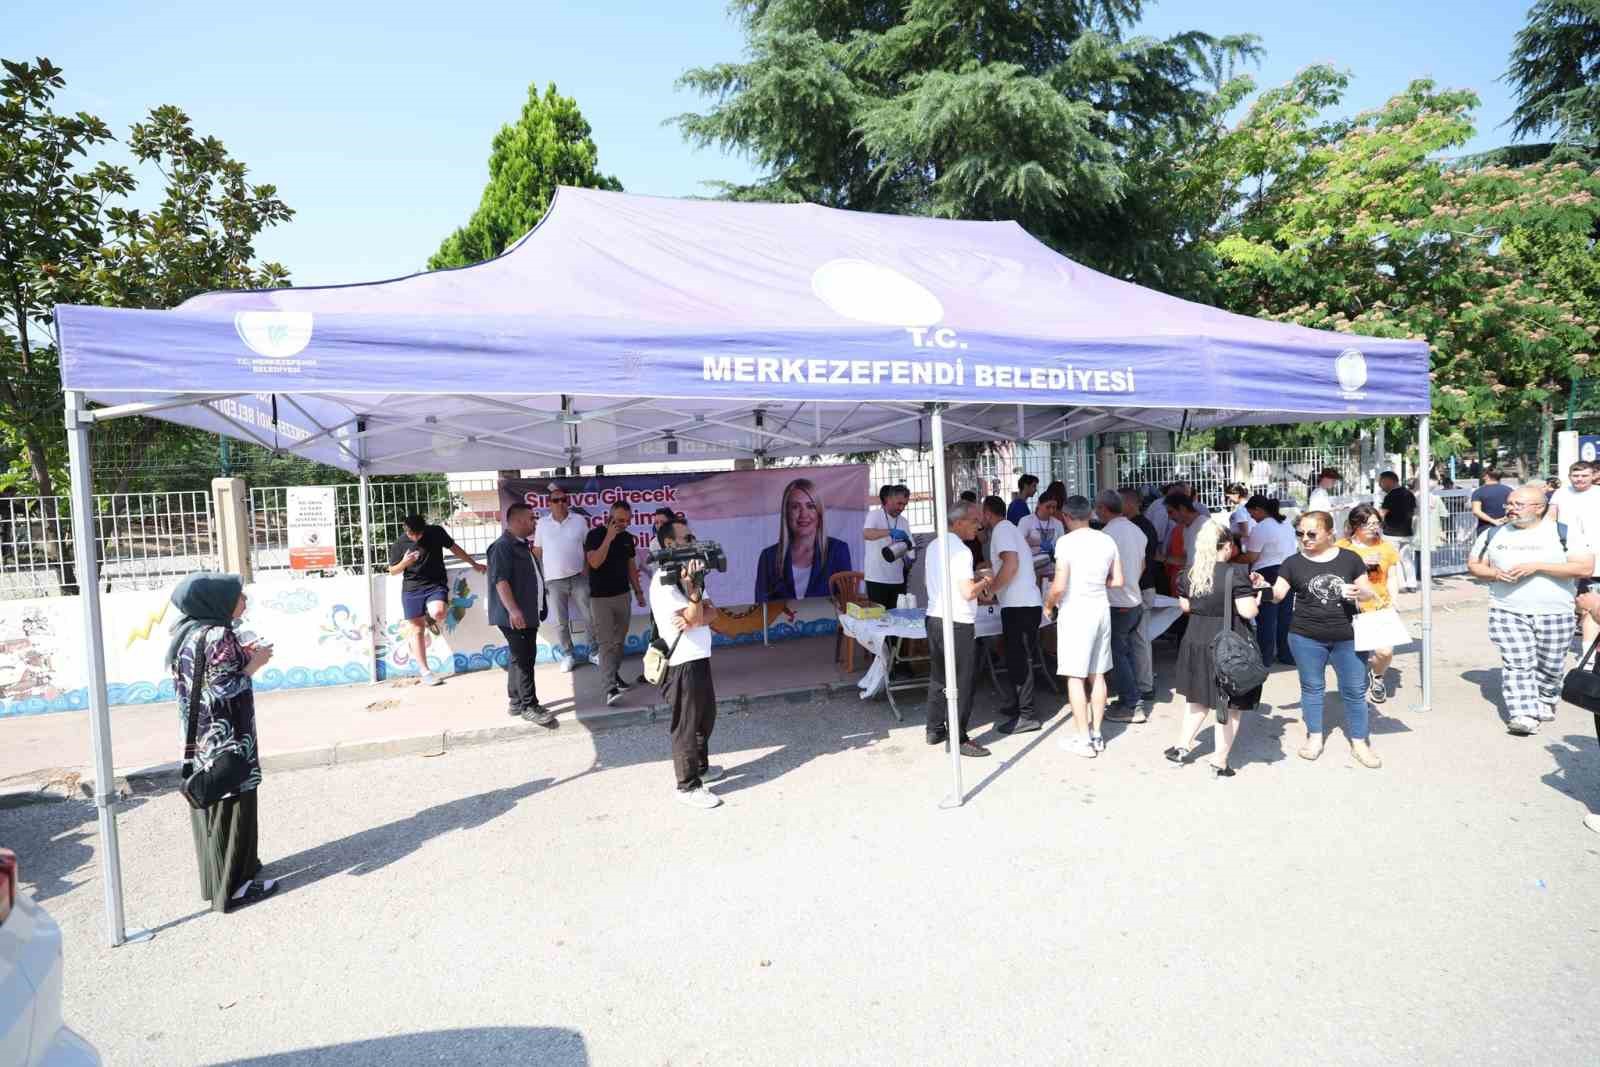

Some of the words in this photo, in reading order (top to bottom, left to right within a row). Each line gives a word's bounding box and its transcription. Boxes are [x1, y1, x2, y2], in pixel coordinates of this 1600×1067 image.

[904, 327, 968, 350] T.C.
[703, 356, 964, 386] MERKEZEFENDİ
[975, 364, 1135, 393] BELEDİYESİ
[602, 485, 676, 505] Girecek
